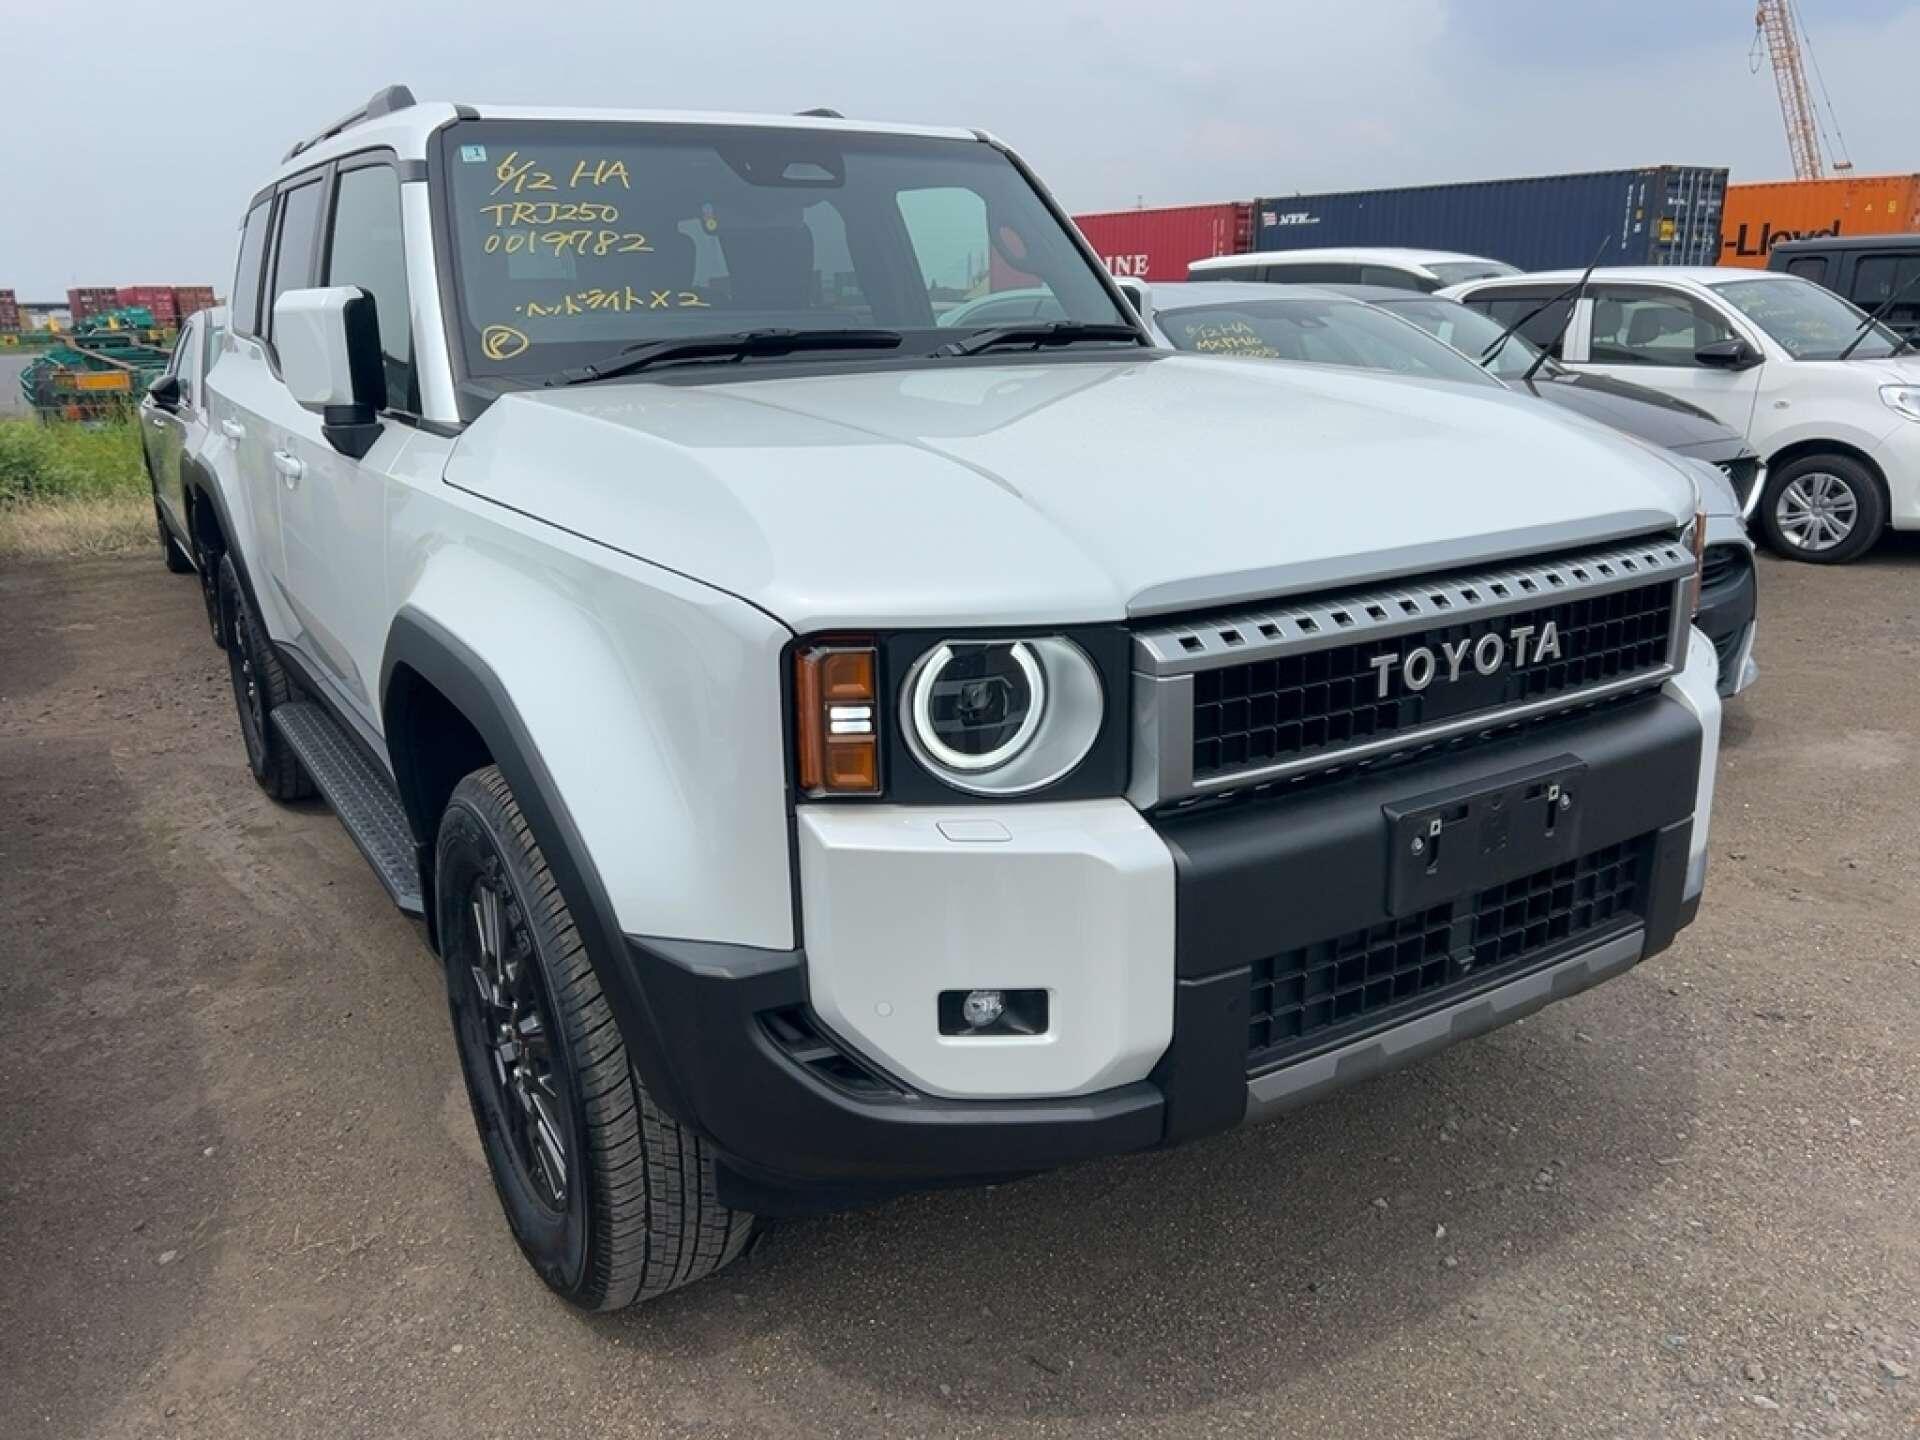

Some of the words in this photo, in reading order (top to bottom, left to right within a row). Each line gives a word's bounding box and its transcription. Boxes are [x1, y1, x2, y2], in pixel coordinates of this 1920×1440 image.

[490, 151, 557, 195] 6/12
[569, 160, 630, 189] HA
[480, 202, 619, 226] TRJ250
[484, 230, 655, 257] 0019782
[1370, 620, 1561, 698] TOYOTA
